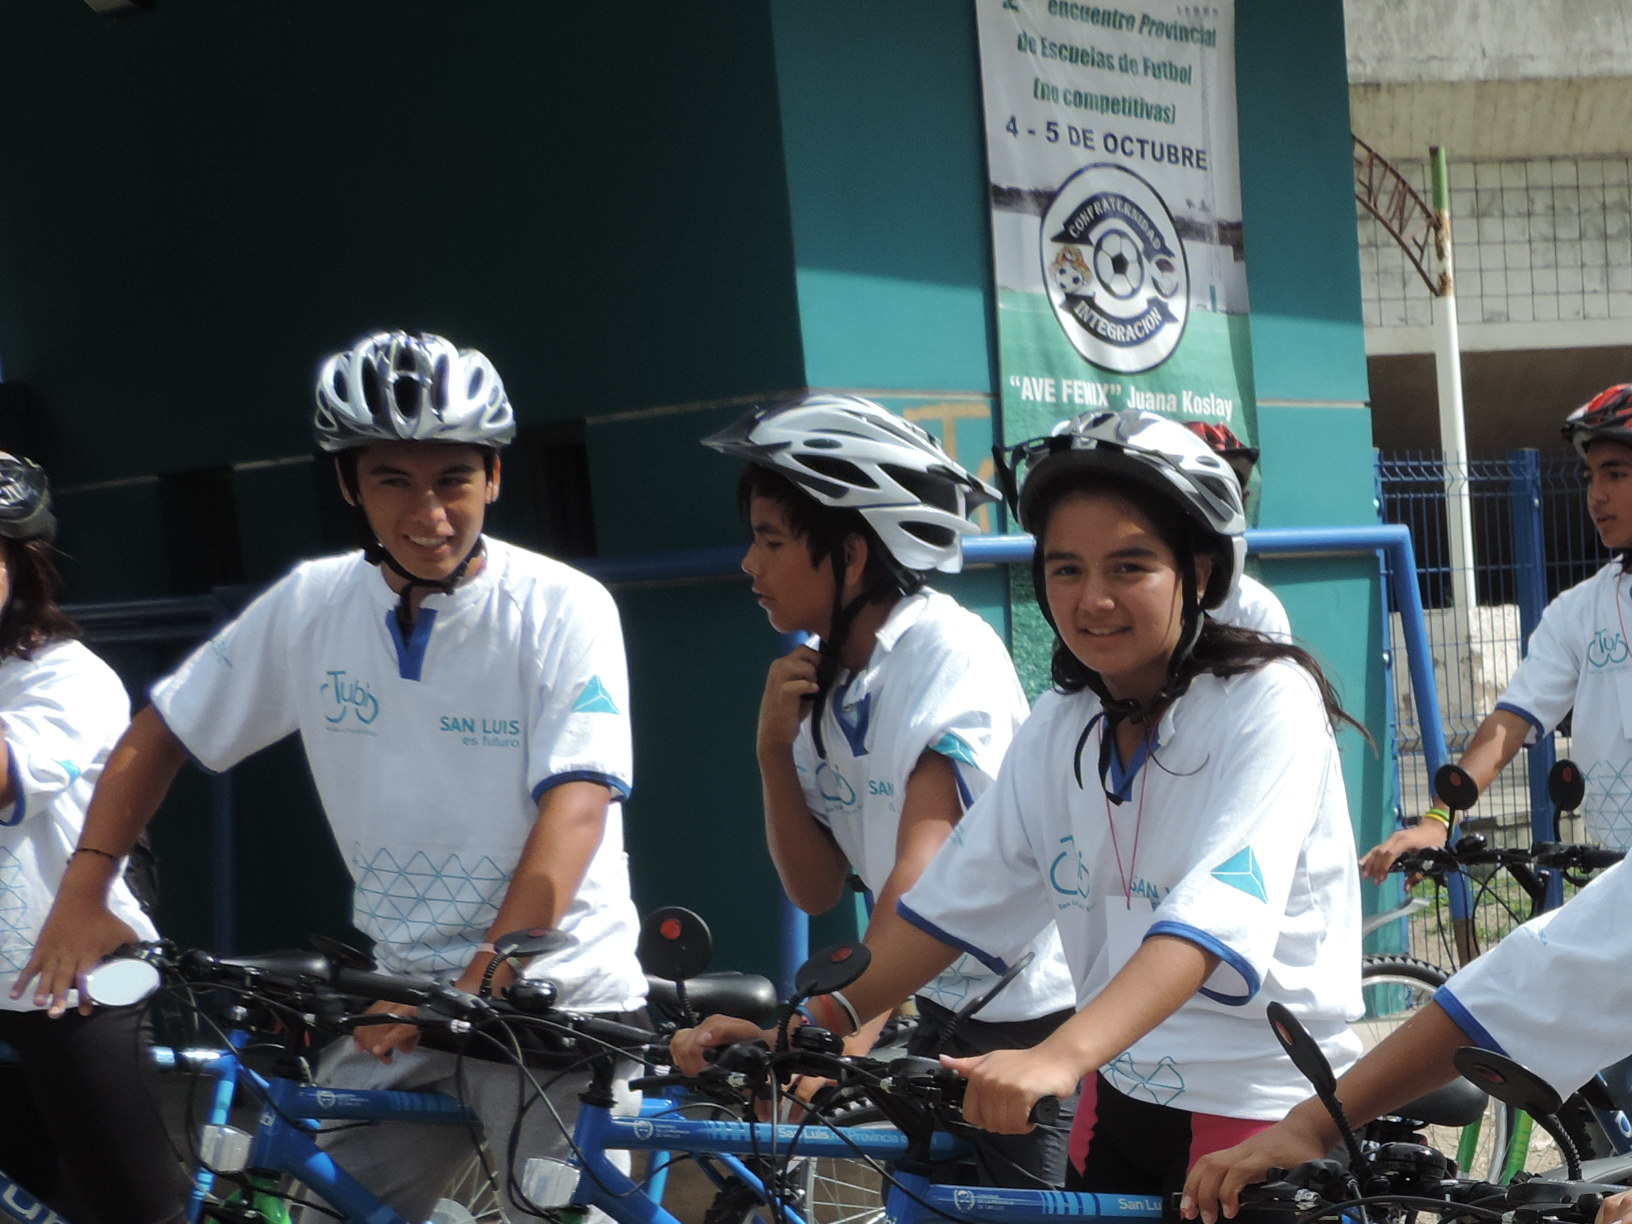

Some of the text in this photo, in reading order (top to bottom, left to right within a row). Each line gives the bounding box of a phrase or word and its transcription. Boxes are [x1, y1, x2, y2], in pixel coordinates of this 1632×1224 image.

[1138, 13, 1217, 48] Provincial
[1041, 37, 1115, 72] Escuelas
[1118, 54, 1140, 75] de
[1143, 60, 1193, 85] Futbol
[1033, 78, 1176, 125] (no competitivas)
[1006, 115, 1019, 137] 4
[1046, 121, 1060, 143] 5
[1068, 126, 1096, 150] DE
[1103, 133, 1208, 171] OCTUBRE
[1068, 196, 1162, 250] CONFRATERNIDAD
[1074, 301, 1163, 342] INTEGRACION
[1127, 385, 1178, 412] Juana
[1182, 390, 1233, 421] Koslay
[440, 716, 521, 736] SAN LUIS
[462, 735, 521, 748] es futuro
[1118, 1198, 1142, 1210] San
